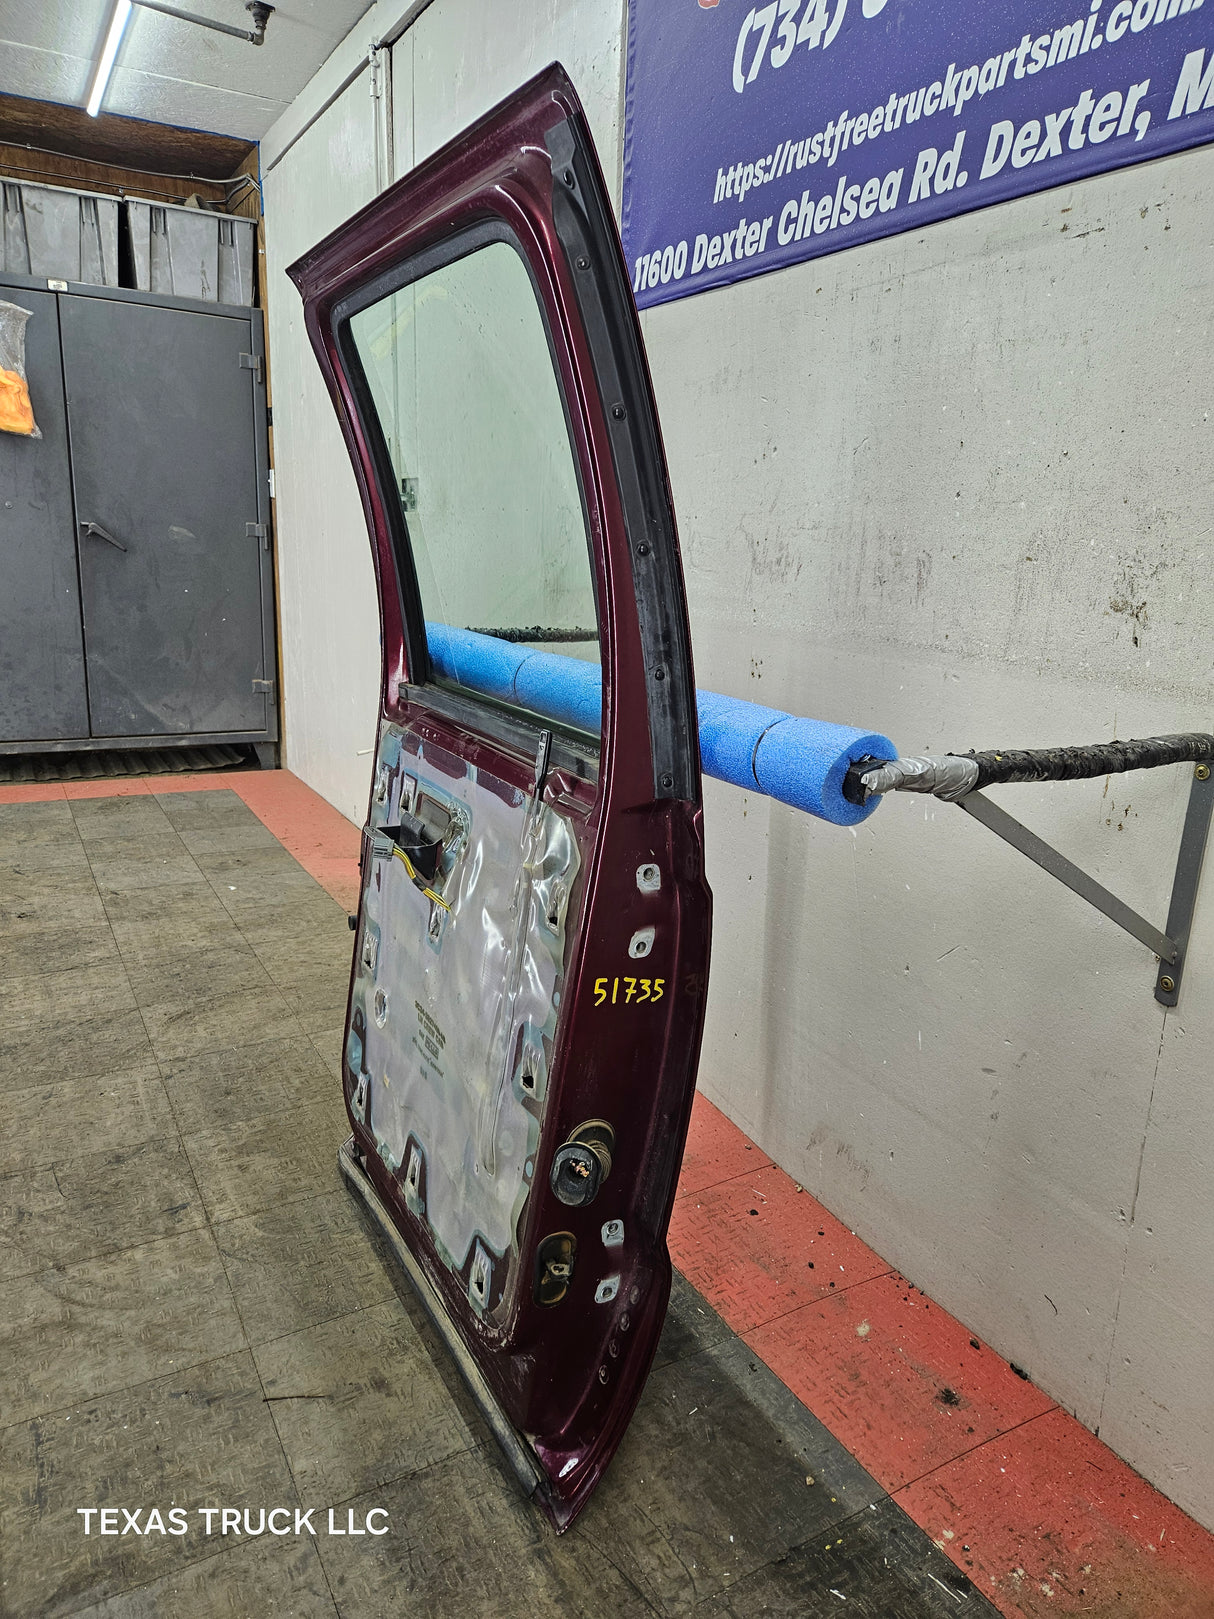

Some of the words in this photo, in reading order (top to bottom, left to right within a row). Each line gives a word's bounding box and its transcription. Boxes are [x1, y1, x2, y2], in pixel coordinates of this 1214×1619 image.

[713, 0, 1205, 204] https://rustfreetruckpartsmi.com
[732, 0, 848, 93] (734)
[633, 240, 688, 293] 11600
[691, 215, 773, 275] Dexter
[777, 168, 904, 246] Chelsea
[908, 130, 969, 204] Rd.
[979, 78, 1151, 181] Dexter,
[594, 977, 665, 1006] 51735
